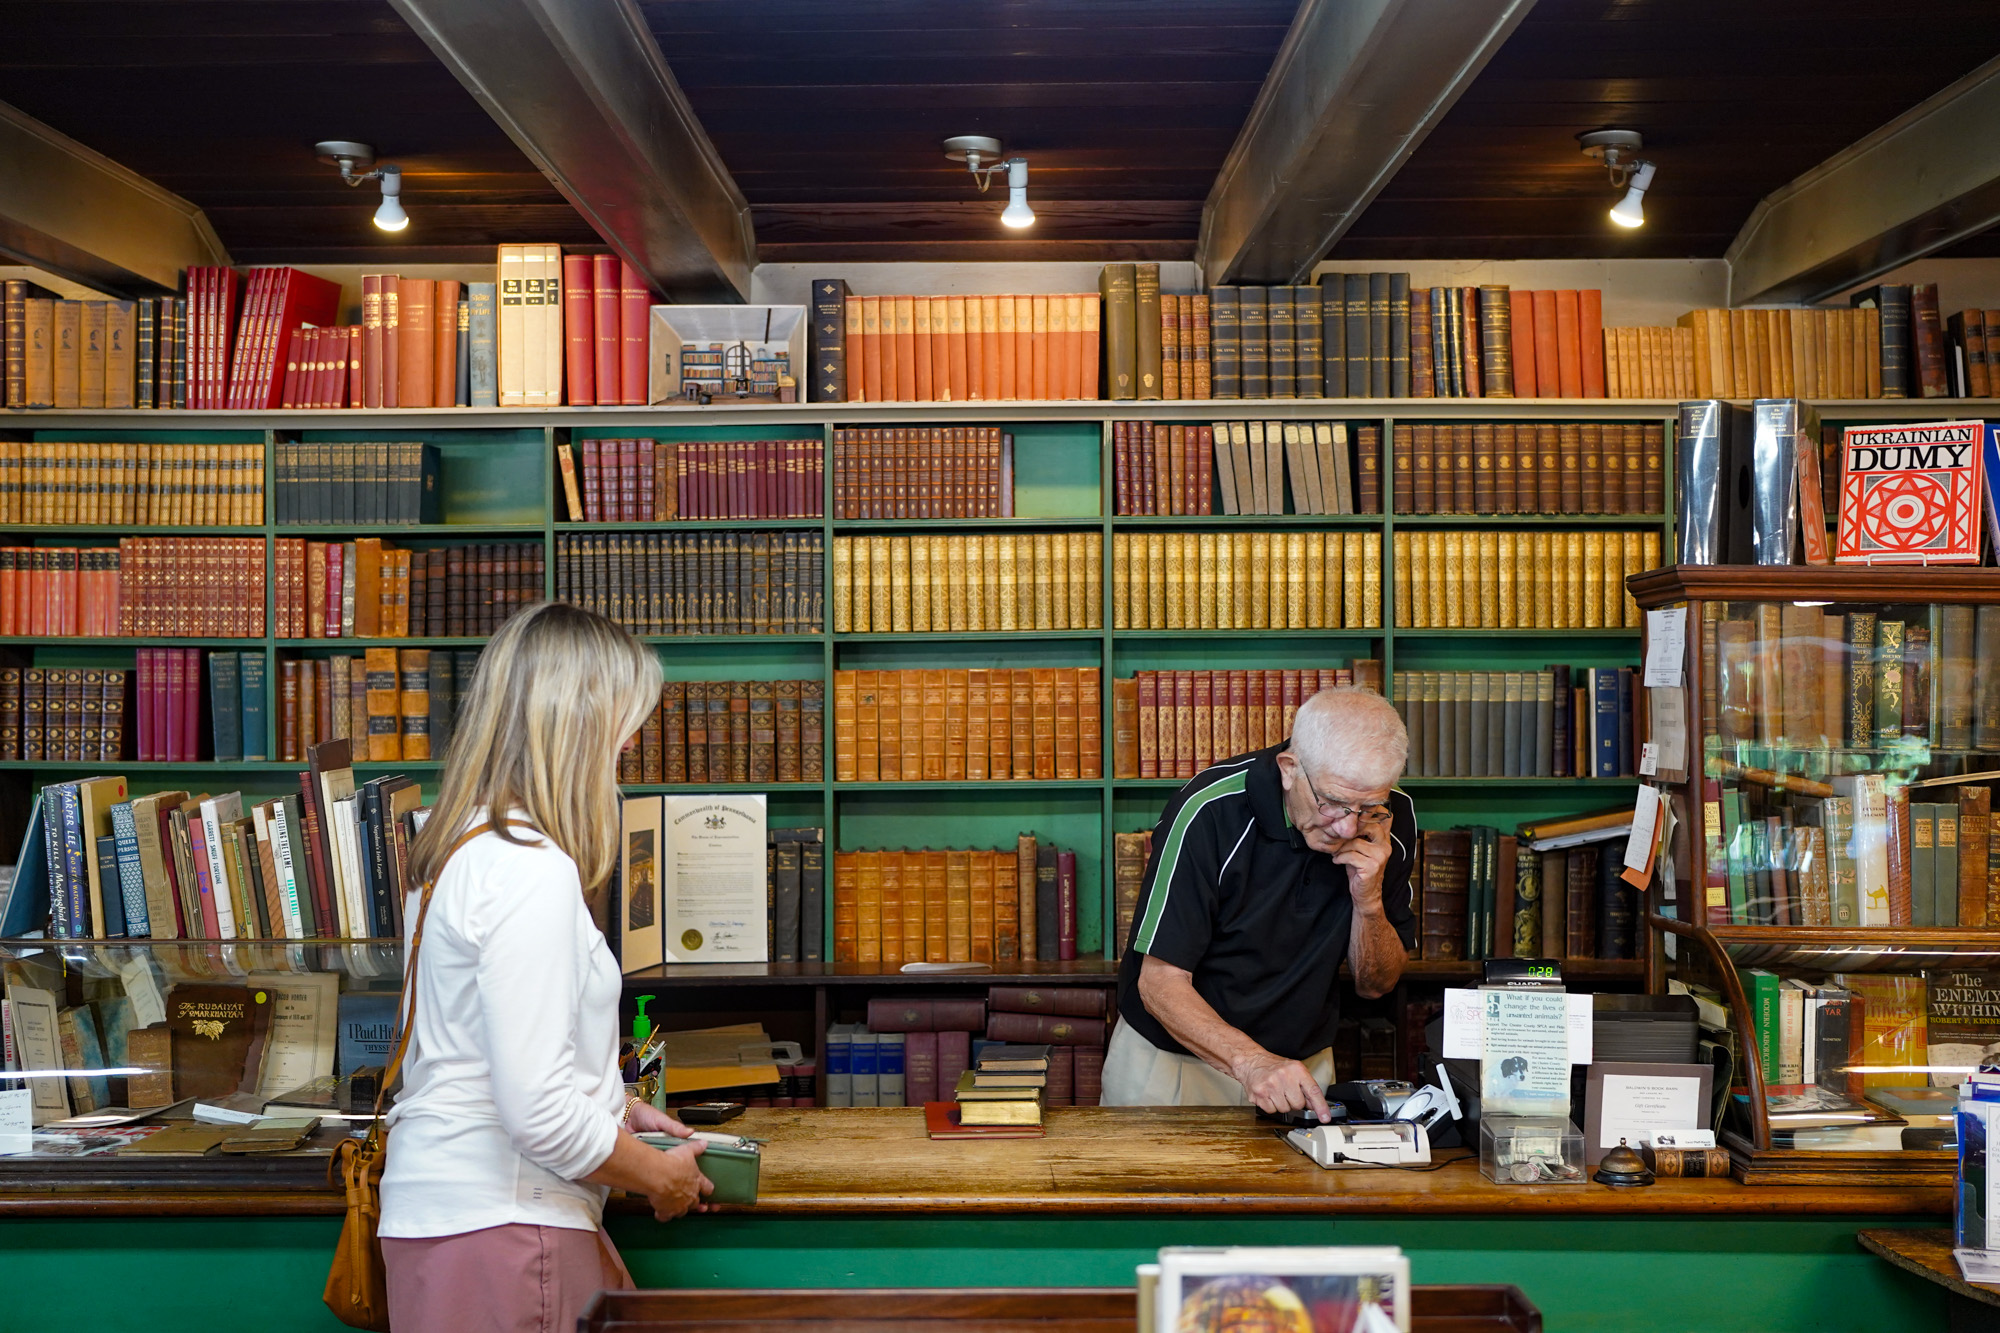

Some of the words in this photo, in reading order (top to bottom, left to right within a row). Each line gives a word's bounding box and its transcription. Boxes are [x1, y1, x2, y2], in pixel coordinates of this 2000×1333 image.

[1852, 428, 1973, 446] UKRAINIAN
[1850, 444, 1972, 472] DUMY
[64, 790, 74, 826] HARPER
[674, 805, 713, 825] Commonwealth
[722, 805, 756, 824] Pennsylvania
[52, 827, 57, 837] TO
[276, 810, 287, 839] SHIELDING
[67, 830, 75, 845] LEE
[118, 838, 136, 846] QUEER
[281, 840, 289, 850] THE
[206, 821, 214, 842] GARRETT
[212, 863, 222, 885] FORTUNE
[283, 850, 292, 868] FLAME
[286, 879, 296, 898] HANNA
[54, 873, 67, 922] Mockingbird
[72, 884, 80, 918] WATCHMAN
[1952, 973, 1982, 987] The
[1936, 988, 2000, 1003] ENEMY
[178, 1002, 196, 1010] The
[1825, 1008, 1841, 1016] YAR
[1932, 1003, 2000, 1016] WITHIN
[2, 1003, 10, 1031] TENNESSEE
[1467, 1010, 1483, 1020] SPC
[349, 1024, 353, 1039] I
[355, 1024, 377, 1039] Paid
